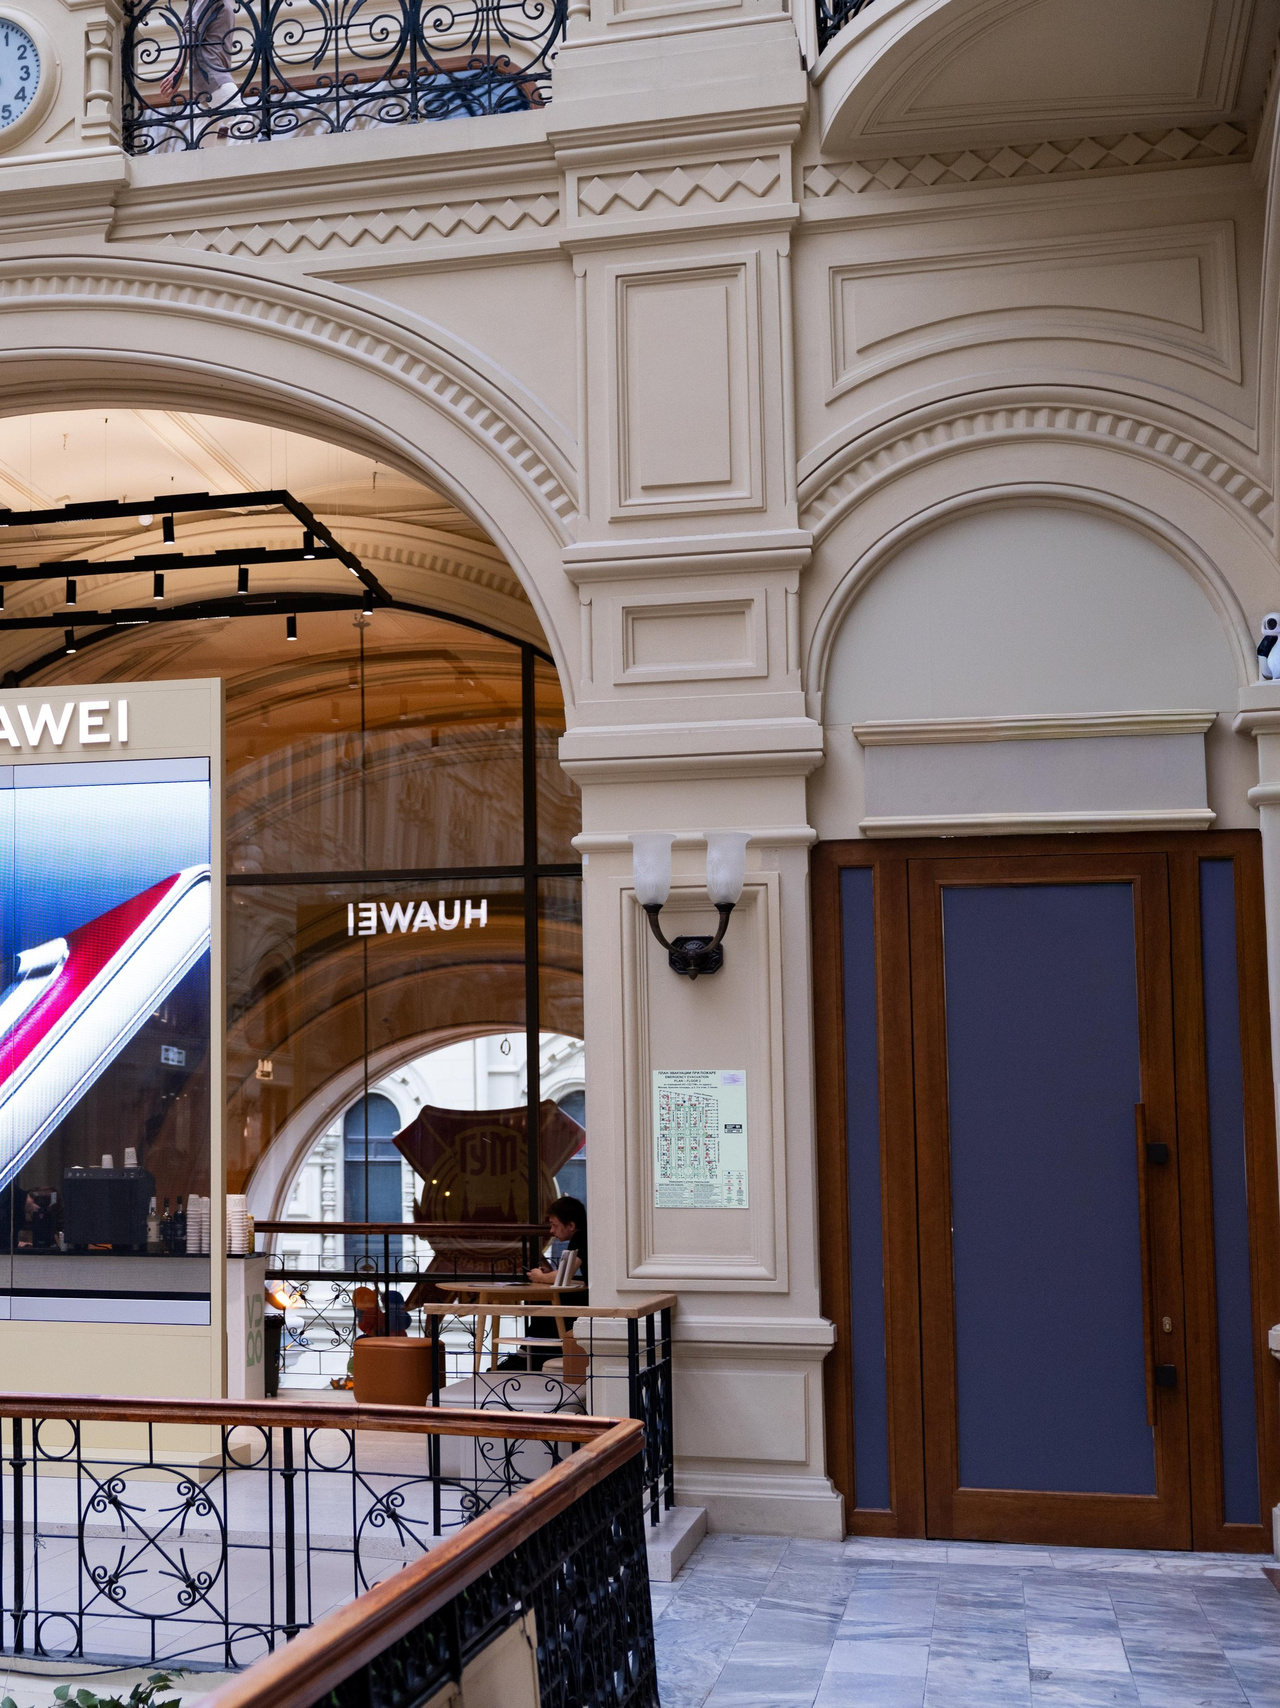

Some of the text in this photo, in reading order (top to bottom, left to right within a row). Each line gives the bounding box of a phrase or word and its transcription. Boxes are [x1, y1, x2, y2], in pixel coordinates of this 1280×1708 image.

[4, 31, 10, 47] 1
[17, 44, 28, 60] 2
[19, 65, 31, 81] 3
[14, 86, 27, 102] 4
[1, 104, 12, 120] 5
[459, 1131, 518, 1176] ГУМ
